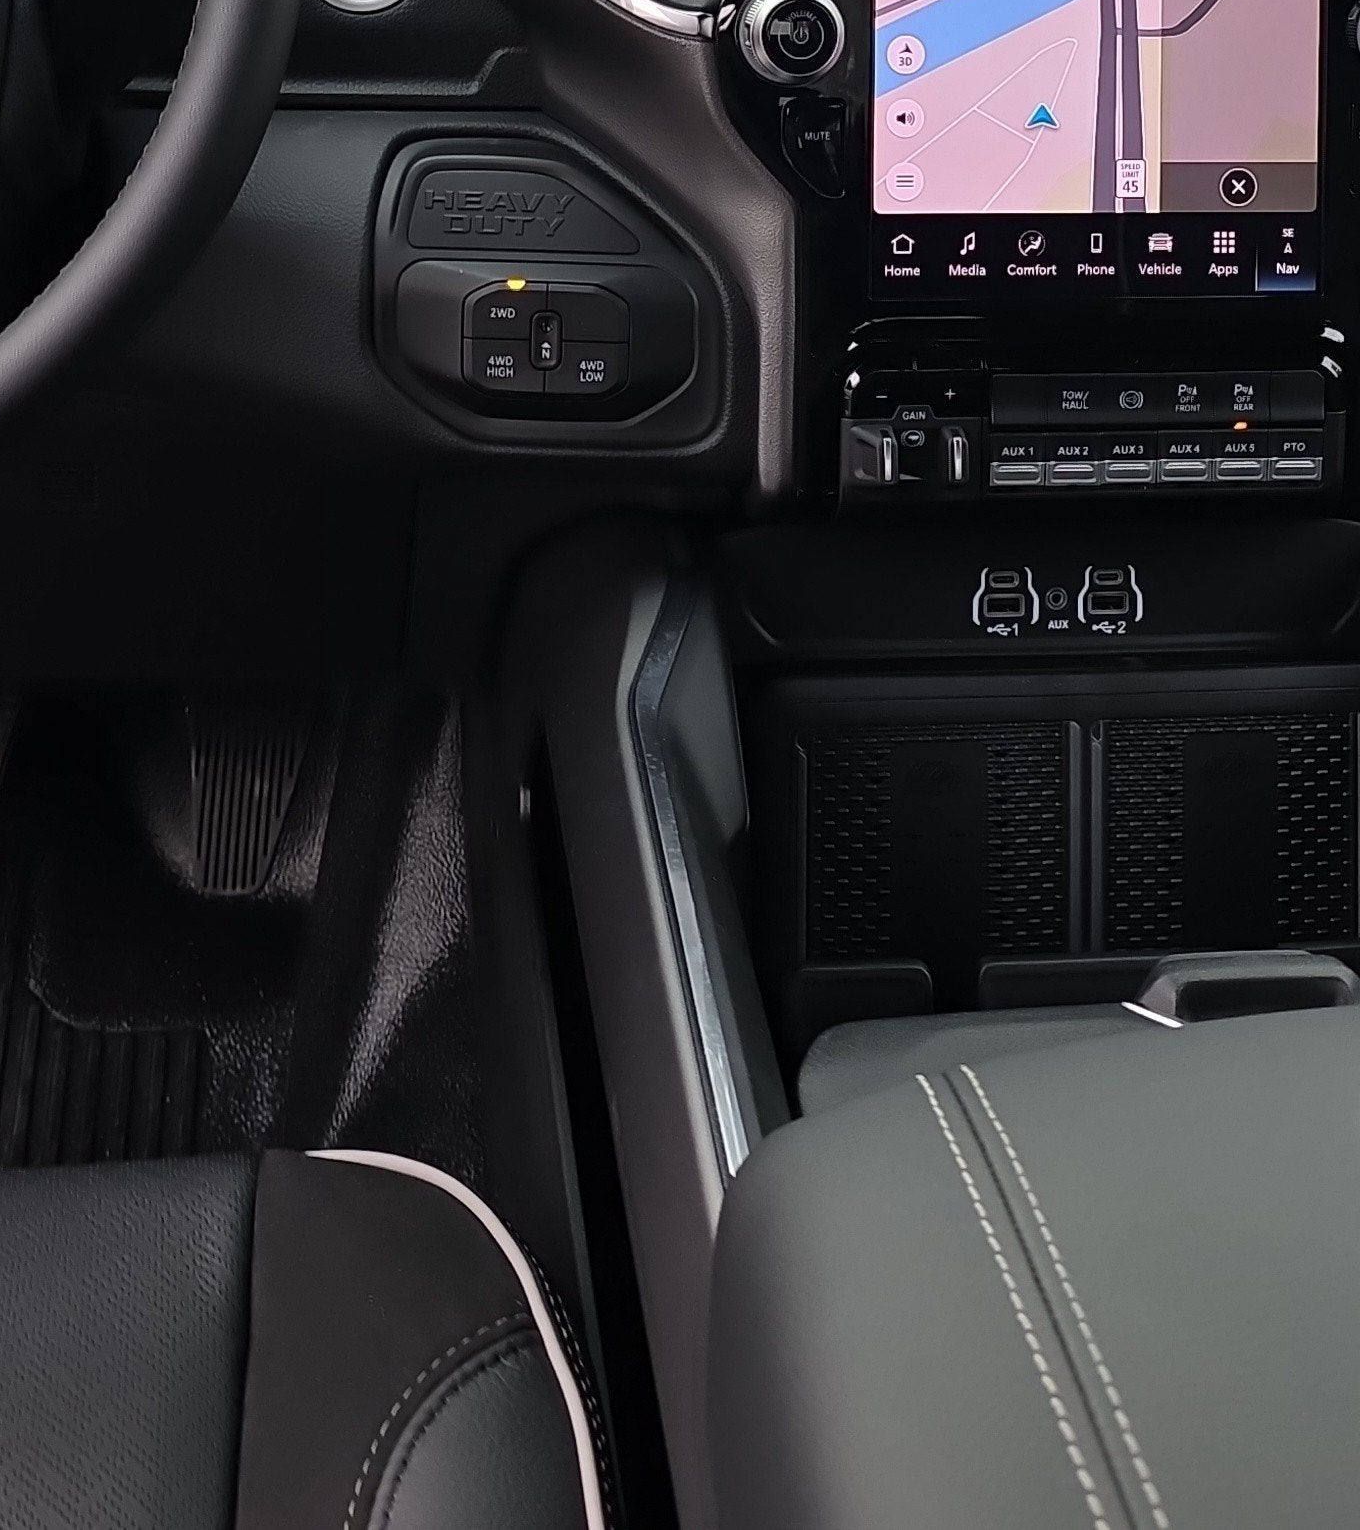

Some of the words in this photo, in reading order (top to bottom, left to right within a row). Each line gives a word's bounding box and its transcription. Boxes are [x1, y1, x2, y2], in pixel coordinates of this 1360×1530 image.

[899, 56, 913, 67] 3D
[804, 131, 831, 141] MUTE
[1122, 180, 1139, 193] 45
[423, 189, 576, 214] HEAVY
[442, 214, 565, 237] DUTY
[1281, 227, 1295, 238] SE
[884, 264, 921, 277] Home
[948, 263, 987, 276] Media
[1007, 263, 1057, 276] Comfort
[1077, 263, 1116, 276] Phone
[1138, 262, 1183, 275] Vehicle
[1208, 262, 1239, 278] Apps
[1276, 262, 1300, 275] Nav
[490, 307, 516, 319] 2WD
[541, 348, 551, 359] N
[487, 355, 514, 366] 4WD
[579, 360, 605, 371] 4WD
[486, 366, 514, 378] HIGH
[579, 371, 605, 383] LOW
[1062, 390, 1089, 401] TOW/
[1180, 396, 1195, 404] OFF
[1236, 395, 1251, 403] OFF
[1062, 400, 1090, 410] HAUL
[1175, 403, 1201, 413] FRONT
[1233, 403, 1254, 411] REAR
[902, 411, 926, 421] GAIN
[1001, 447, 1027, 456] AUX
[1028, 447, 1034, 456] 1
[1057, 446, 1081, 456] AUX
[1082, 446, 1089, 456] 2
[1113, 445, 1135, 455] AUX
[1137, 445, 1144, 455] 3
[1169, 444, 1192, 454] AUX
[1193, 444, 1200, 454] 4
[1224, 443, 1247, 453] AUX
[1248, 443, 1255, 453] 5
[1283, 442, 1306, 452] PTO
[1011, 623, 1019, 637] 1
[1047, 620, 1069, 630] AUX
[1117, 621, 1127, 634] 2
